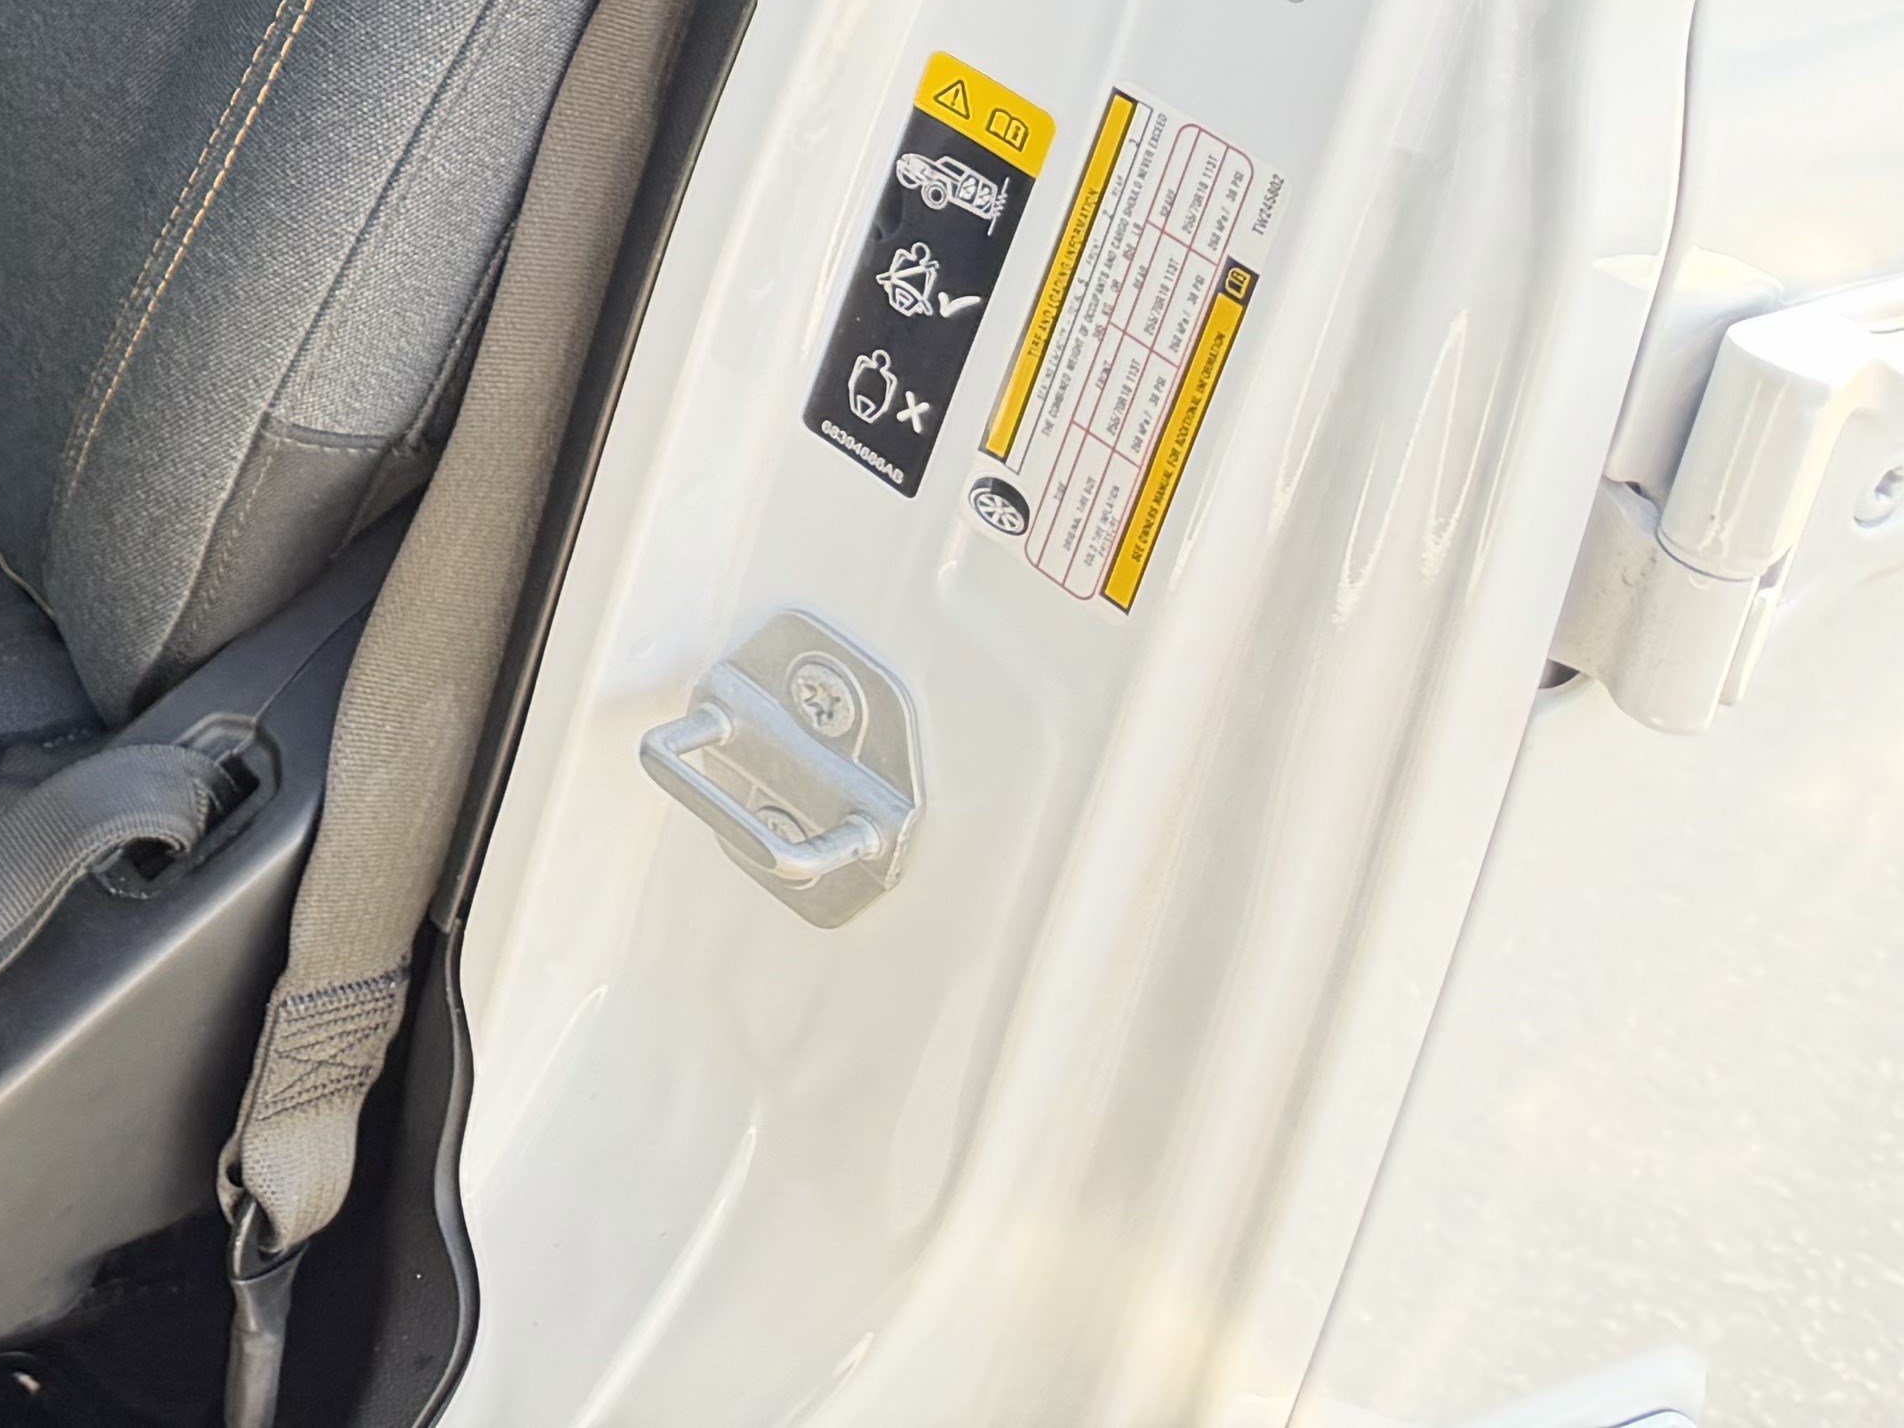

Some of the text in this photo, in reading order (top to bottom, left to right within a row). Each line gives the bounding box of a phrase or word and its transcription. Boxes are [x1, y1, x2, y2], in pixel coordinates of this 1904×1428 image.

[1061, 184, 1099, 262] INFORMATION
[1250, 171, 1286, 238] TW245802
[1044, 257, 1072, 310] LOADING
[1035, 305, 1054, 333] AND
